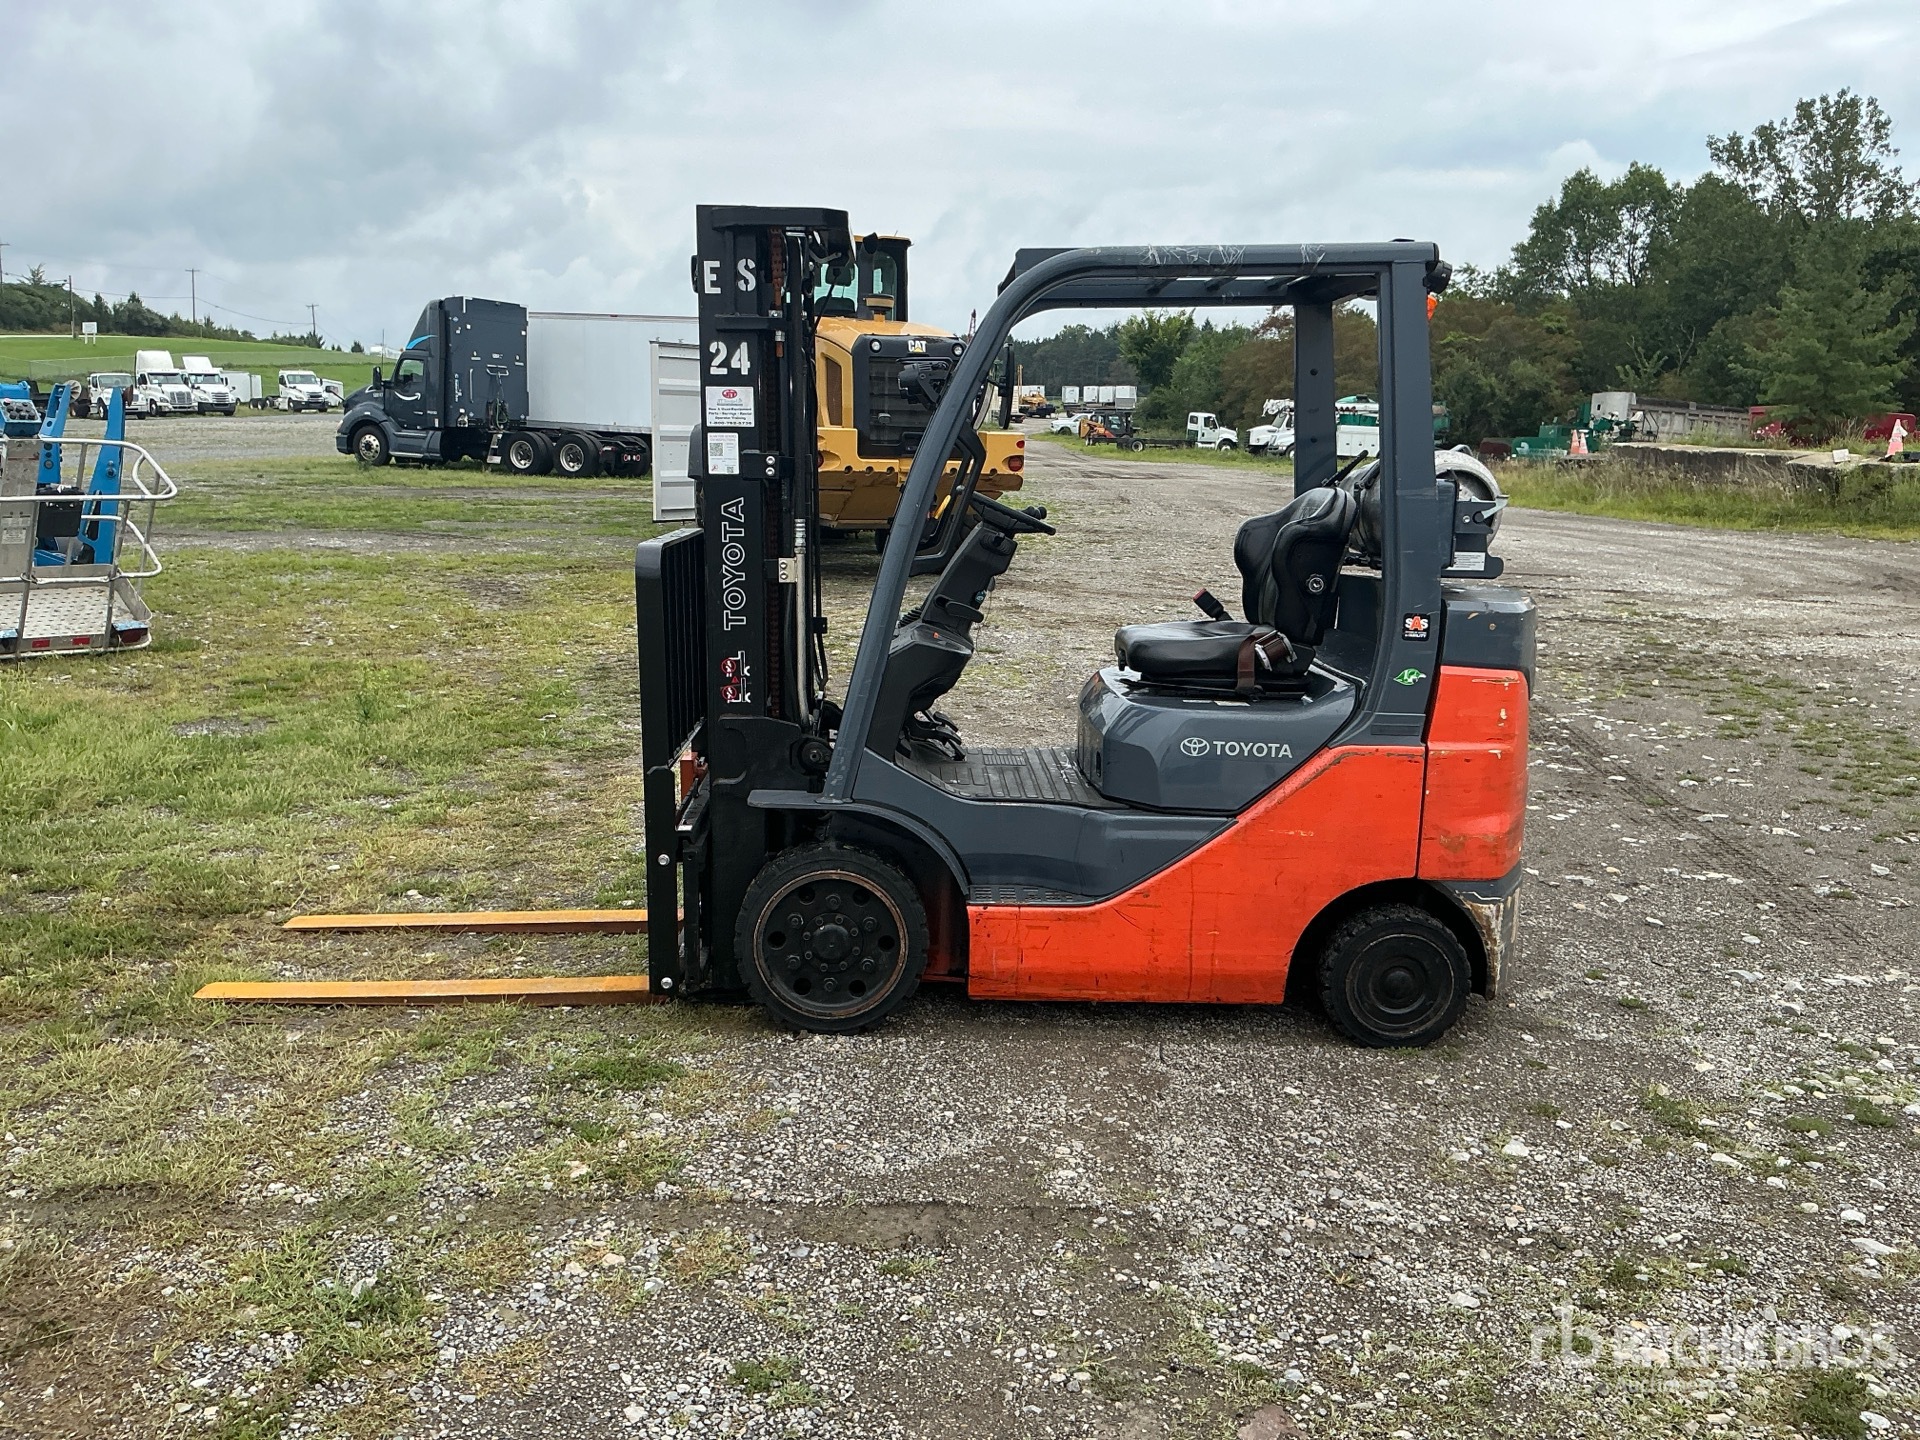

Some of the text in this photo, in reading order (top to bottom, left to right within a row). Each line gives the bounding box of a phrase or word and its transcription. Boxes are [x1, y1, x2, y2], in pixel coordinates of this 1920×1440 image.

[703, 258, 756, 294] E S
[709, 341, 751, 375] 24
[907, 340, 927, 353] CAT
[721, 496, 747, 631] TOYOTA
[1404, 616, 1429, 630] SAS
[1213, 740, 1293, 758] TOYOTA
